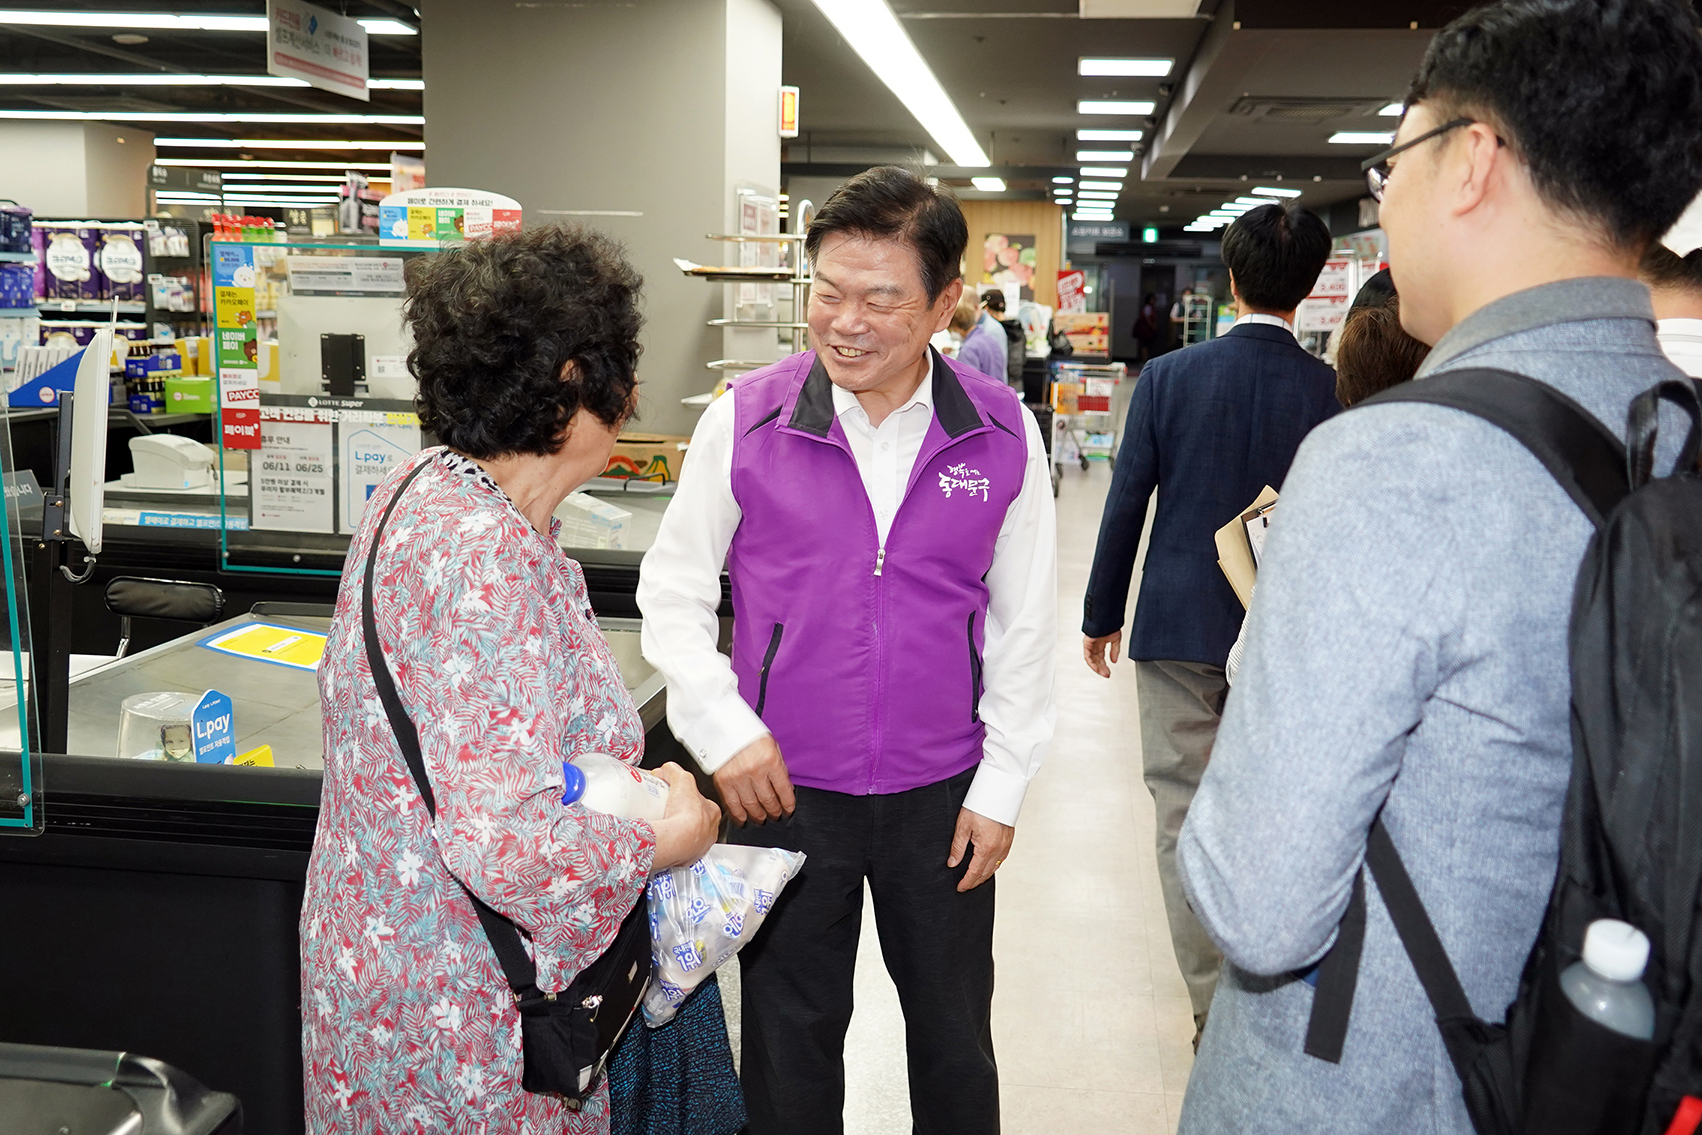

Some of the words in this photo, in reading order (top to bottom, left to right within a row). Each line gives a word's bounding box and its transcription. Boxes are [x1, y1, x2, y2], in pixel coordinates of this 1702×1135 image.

[220, 298, 249, 306] 카카오페이
[222, 331, 246, 341] 네이버
[222, 341, 238, 350] 페이
[341, 400, 364, 408] Super
[276, 436, 290, 444] 안내
[355, 451, 386, 464] L.pay
[262, 461, 290, 471] 06/11
[295, 463, 323, 473] 06/25
[938, 472, 990, 502] 동대문구
[196, 713, 230, 740] L.pay
